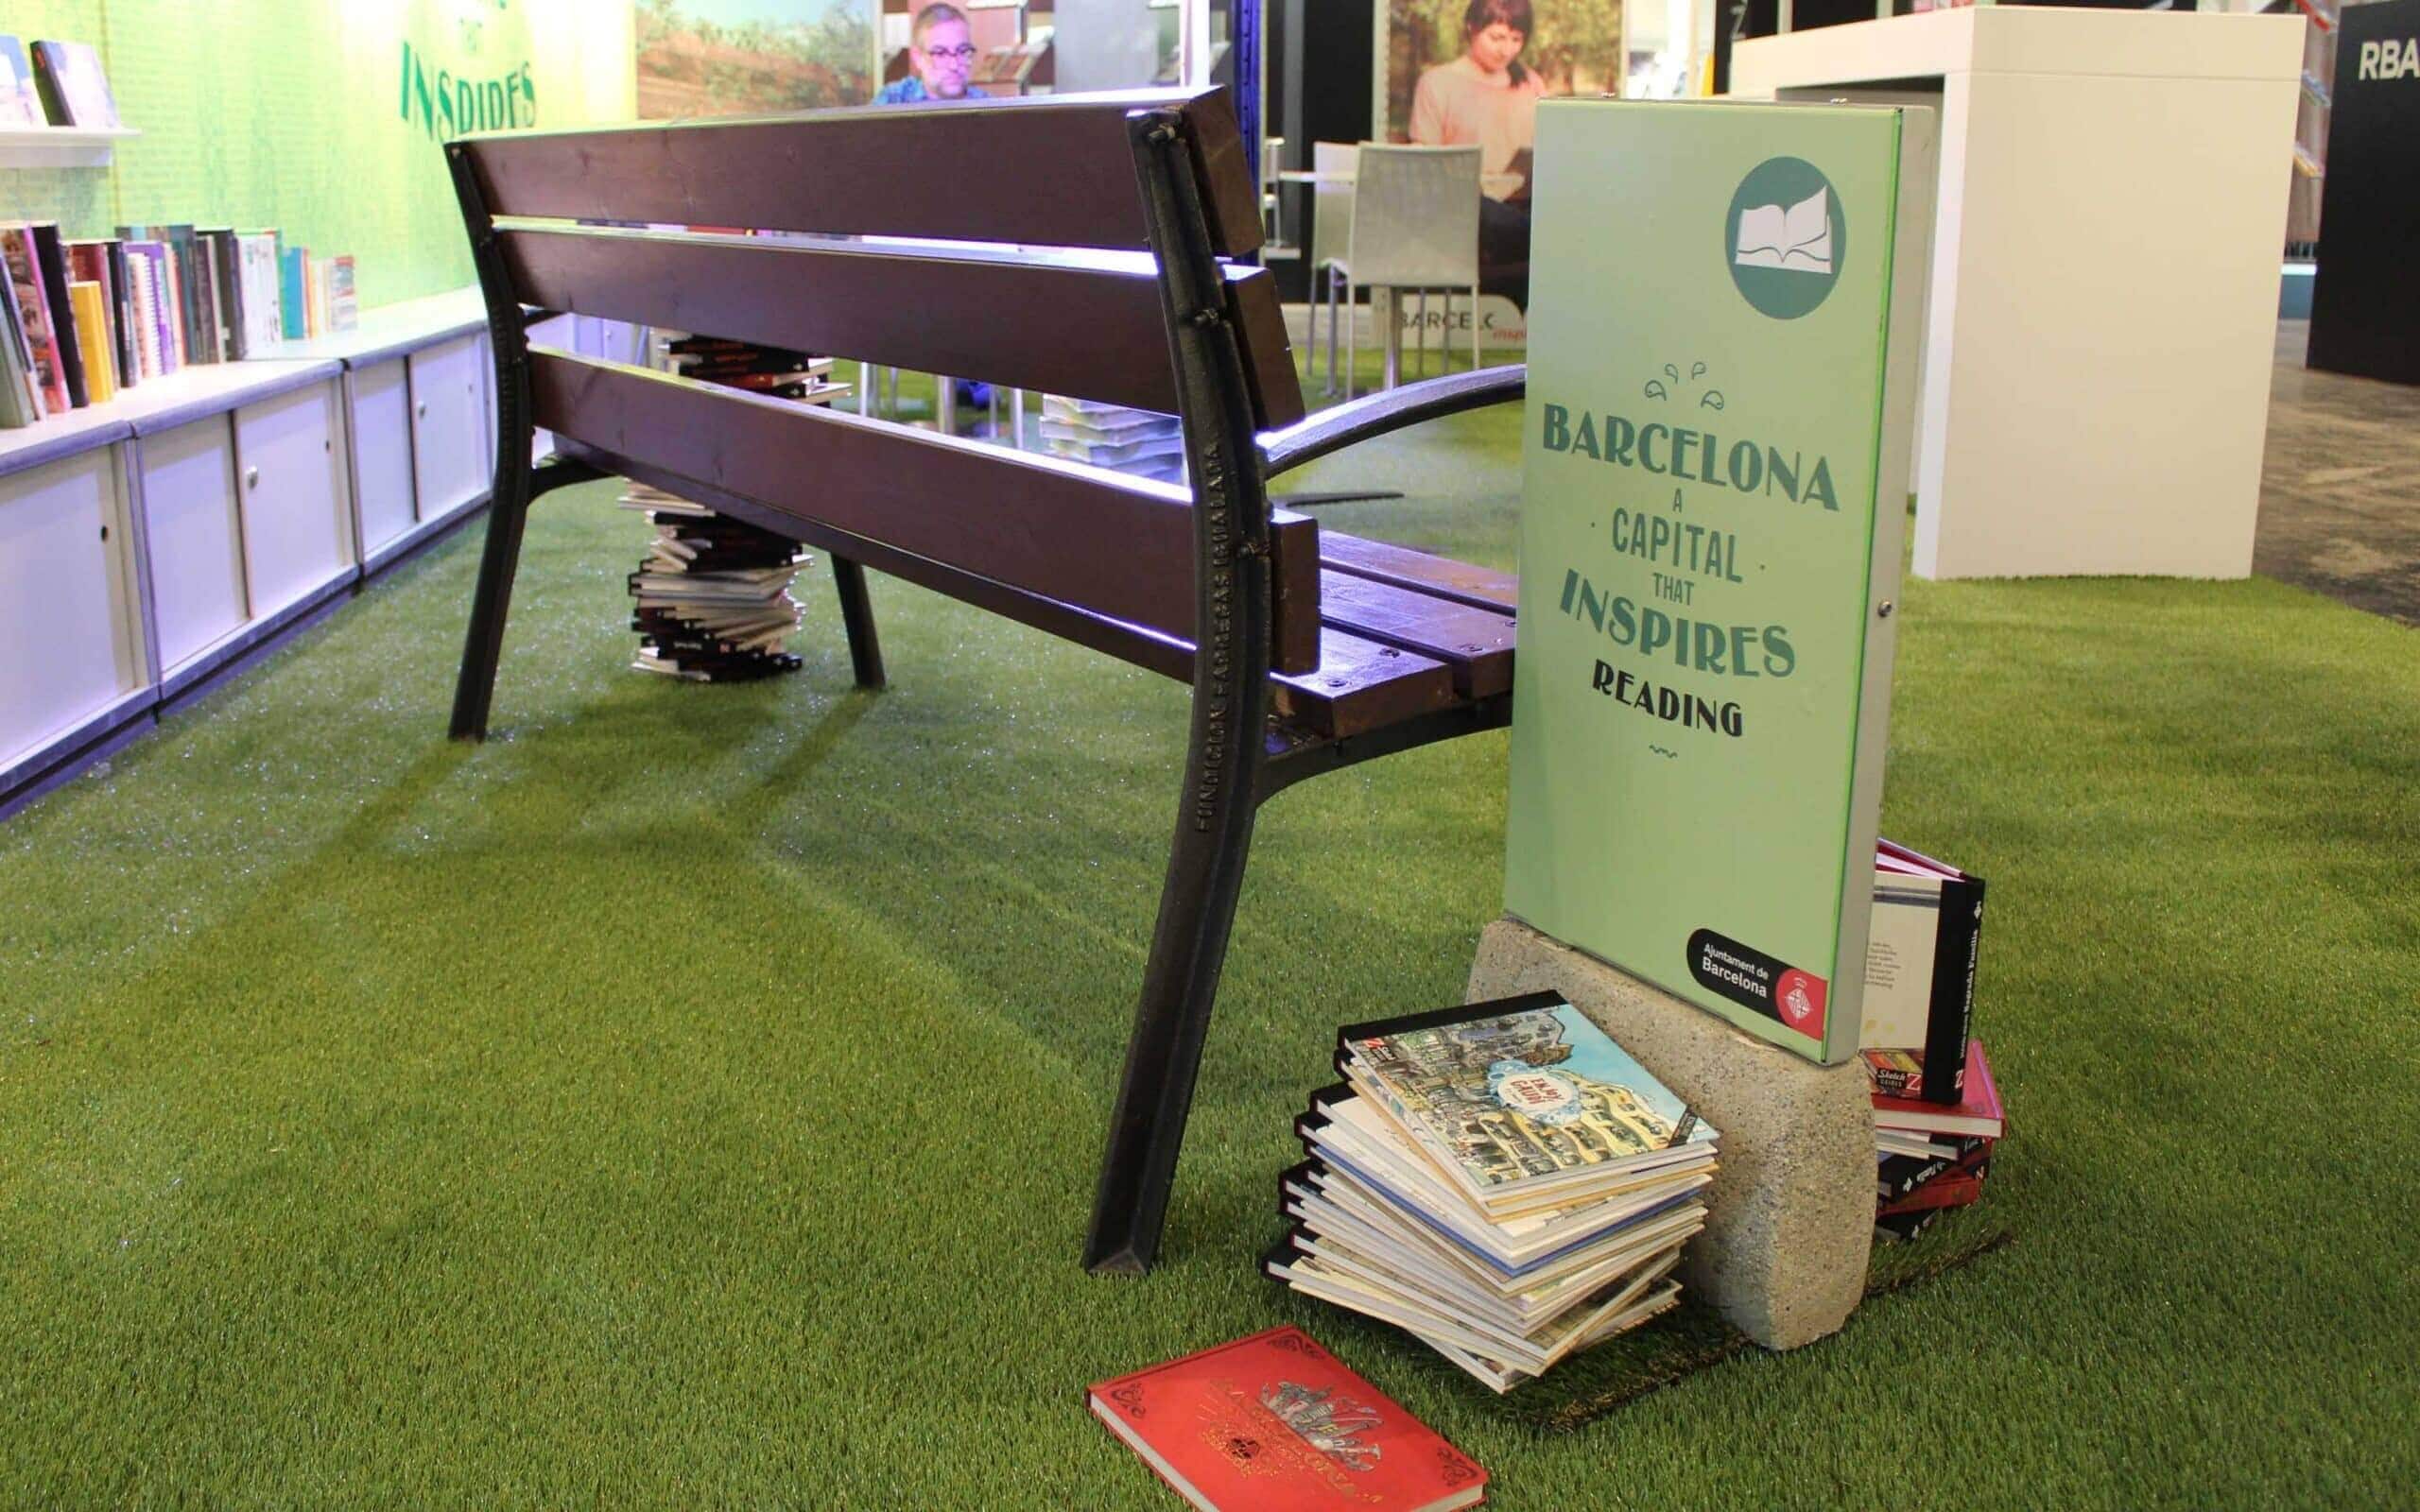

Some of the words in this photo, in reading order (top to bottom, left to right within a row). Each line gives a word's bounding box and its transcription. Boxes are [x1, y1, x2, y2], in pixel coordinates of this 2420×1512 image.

[2359, 38, 2420, 80] RBA
[1543, 403, 1840, 511] BARCELONA
[1671, 488, 1683, 513] A
[1612, 507, 1743, 583] CAPITAL
[1652, 573, 1695, 606] THAT
[1560, 568, 1796, 679] INSPIRES
[1592, 659, 1743, 737] READING
[1702, 956, 1768, 998] Barcelona
[1703, 943, 1755, 974] Ajuntament
[1756, 967, 1770, 981] de
